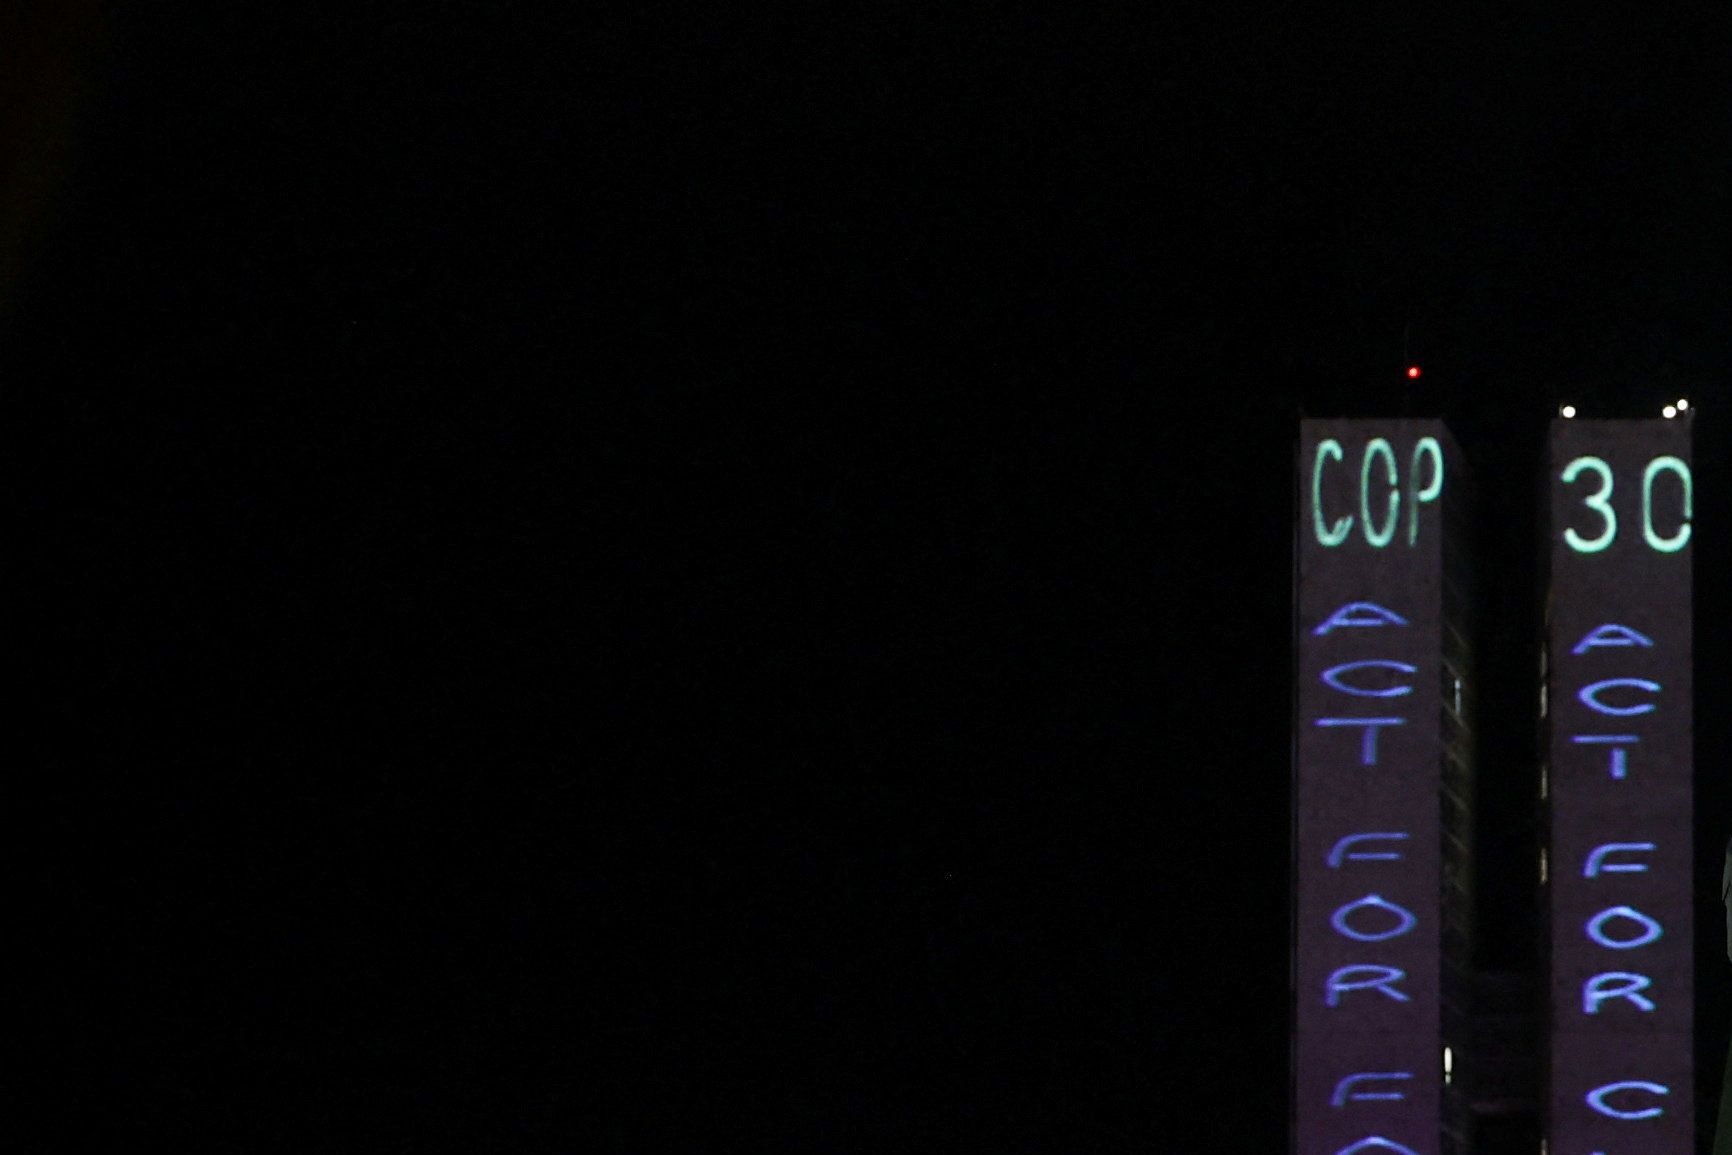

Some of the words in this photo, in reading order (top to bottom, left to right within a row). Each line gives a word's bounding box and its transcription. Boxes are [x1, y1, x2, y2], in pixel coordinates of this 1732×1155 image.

[1312, 436, 1444, 547] COP
[1561, 456, 1693, 553] 30
[1312, 601, 1417, 765] ACT
[1572, 624, 1661, 780] ACT
[1325, 832, 1416, 1007] FOR
[1583, 841, 1663, 1014] FOR
